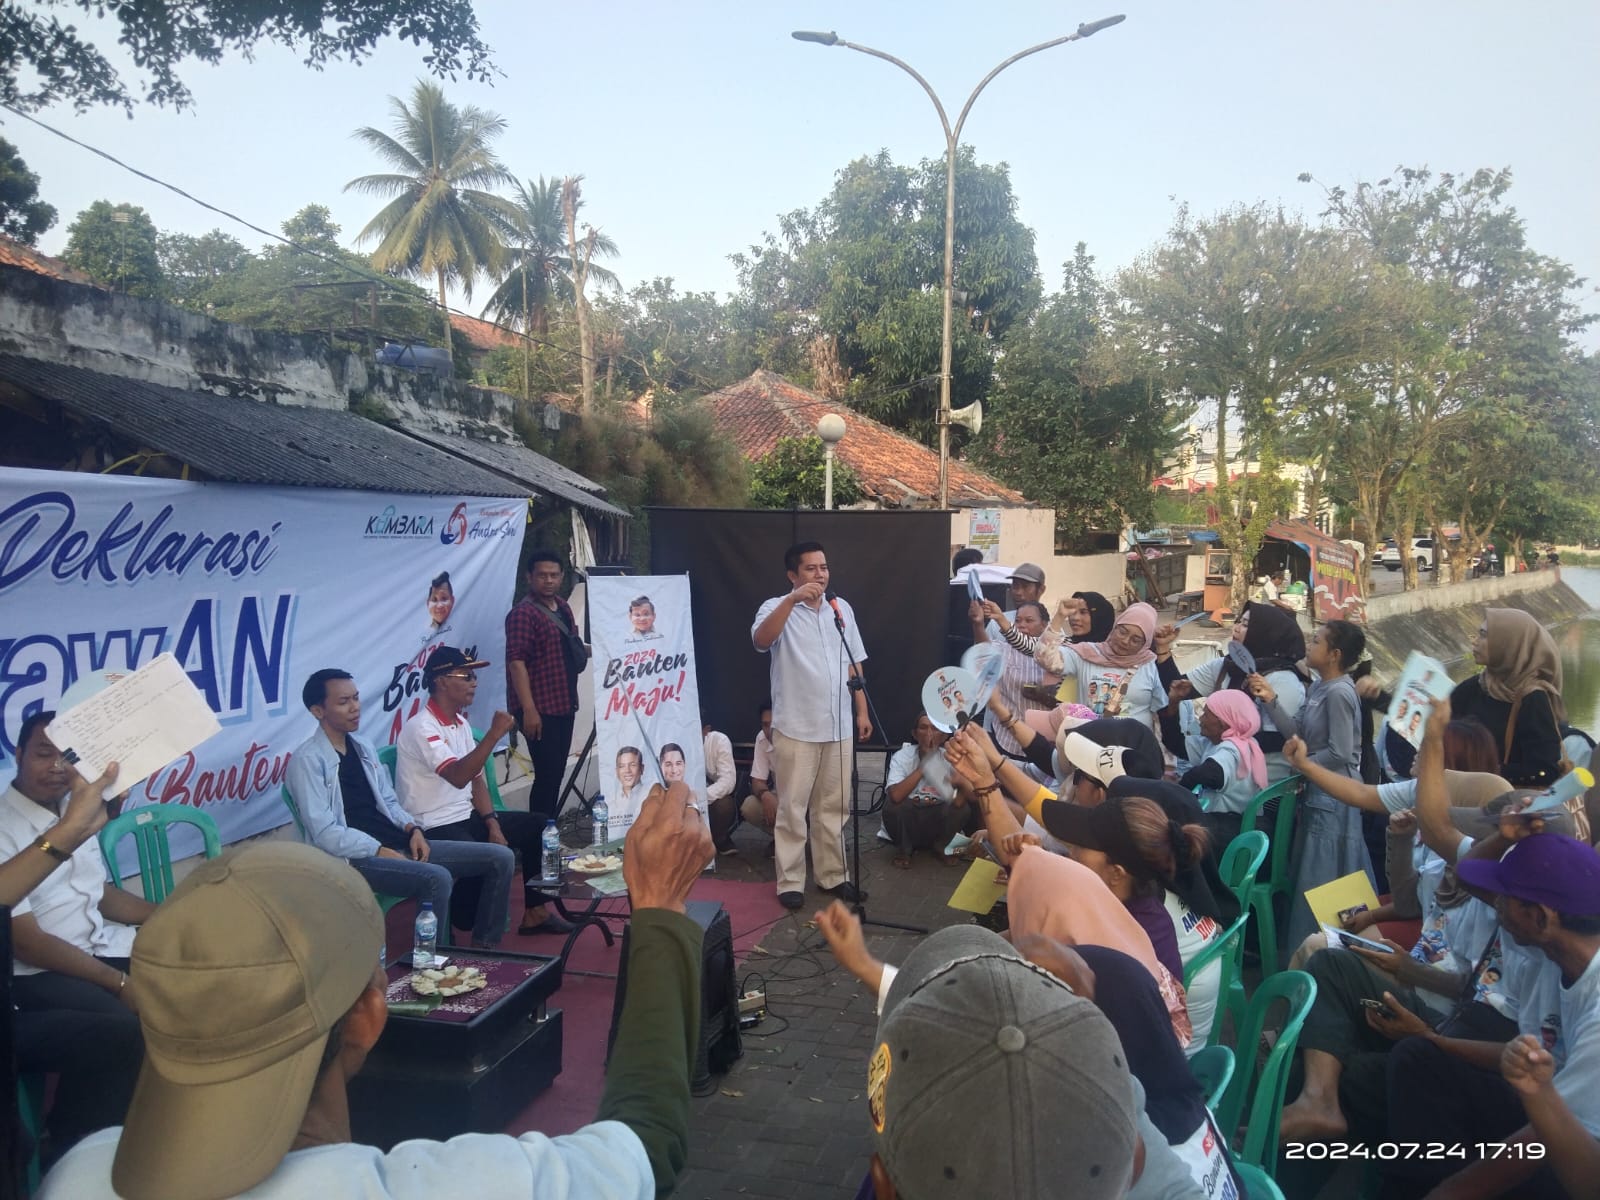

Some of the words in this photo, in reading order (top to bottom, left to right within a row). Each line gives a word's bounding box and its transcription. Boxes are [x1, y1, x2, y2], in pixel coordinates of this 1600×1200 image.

[603, 653, 687, 688] Banten
[604, 670, 686, 720] Maju!
[145, 742, 292, 807] Banten
